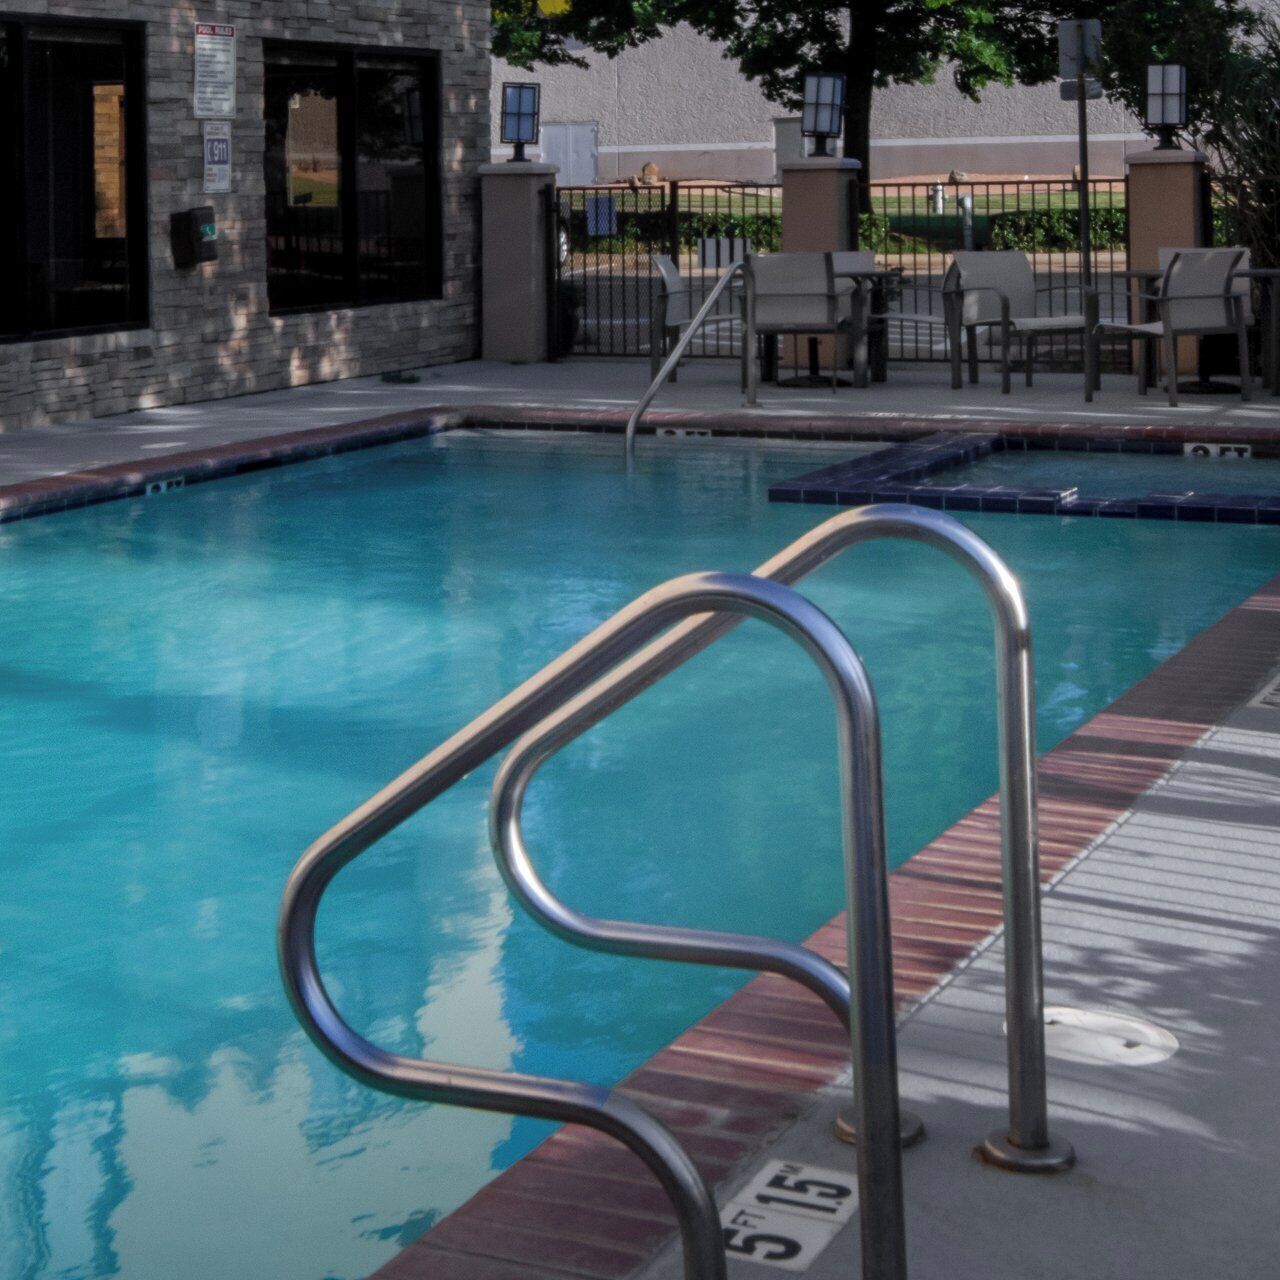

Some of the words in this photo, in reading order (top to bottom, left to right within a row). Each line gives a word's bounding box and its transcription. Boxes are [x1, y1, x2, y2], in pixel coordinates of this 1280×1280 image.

[213, 140, 228, 161] 911
[755, 1174, 852, 1214] 1.5
[731, 1209, 766, 1230] FT
[723, 1227, 803, 1261] 5
